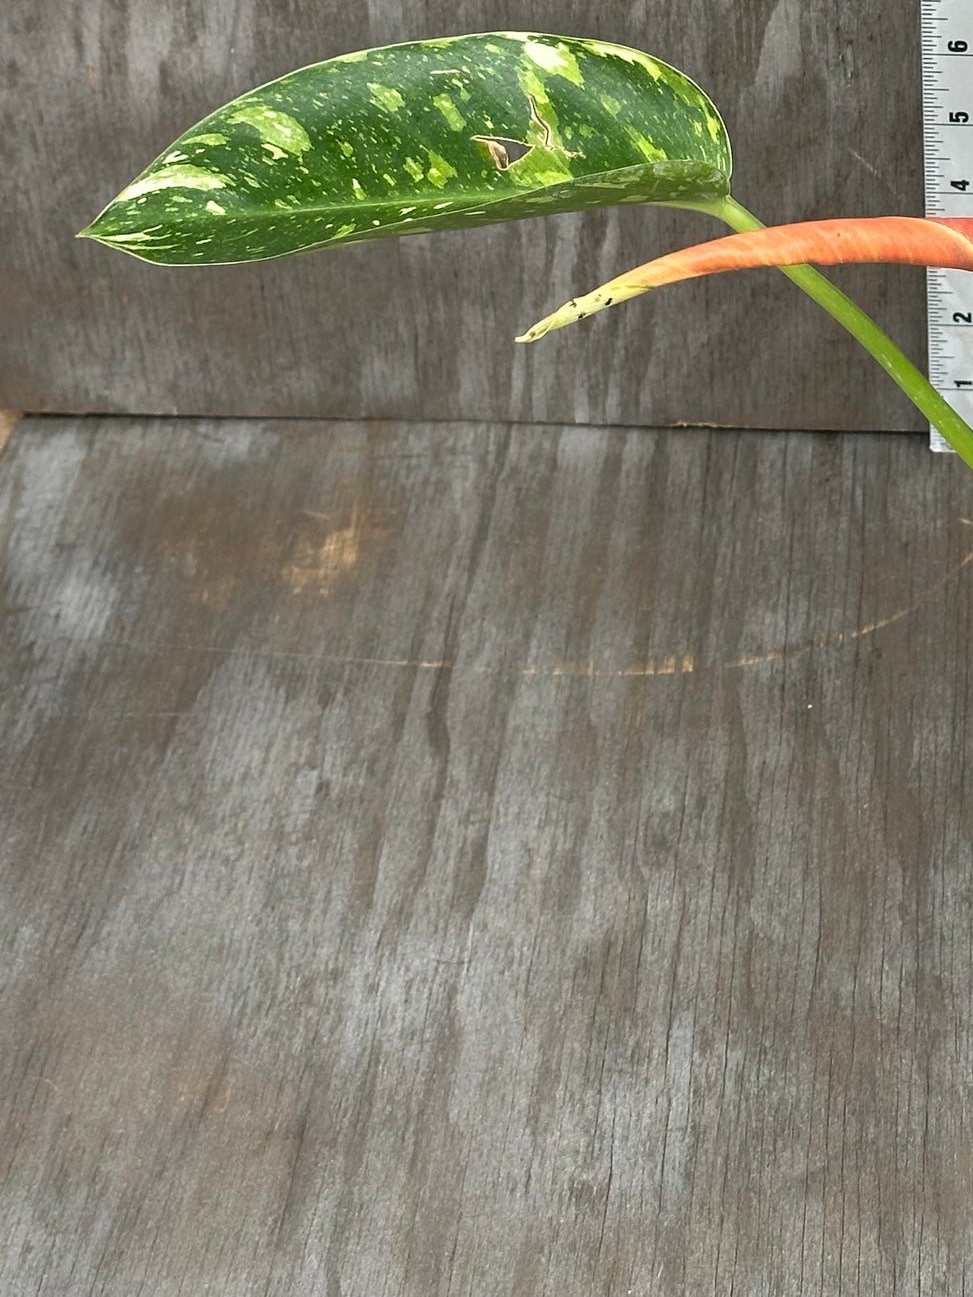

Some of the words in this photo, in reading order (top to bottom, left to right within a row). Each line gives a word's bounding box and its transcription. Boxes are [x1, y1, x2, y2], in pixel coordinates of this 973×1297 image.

[947, 40, 968, 53] 6
[949, 111, 969, 124] 5
[950, 179, 970, 192] 4
[953, 312, 972, 323] 2
[954, 379, 973, 388] 1
